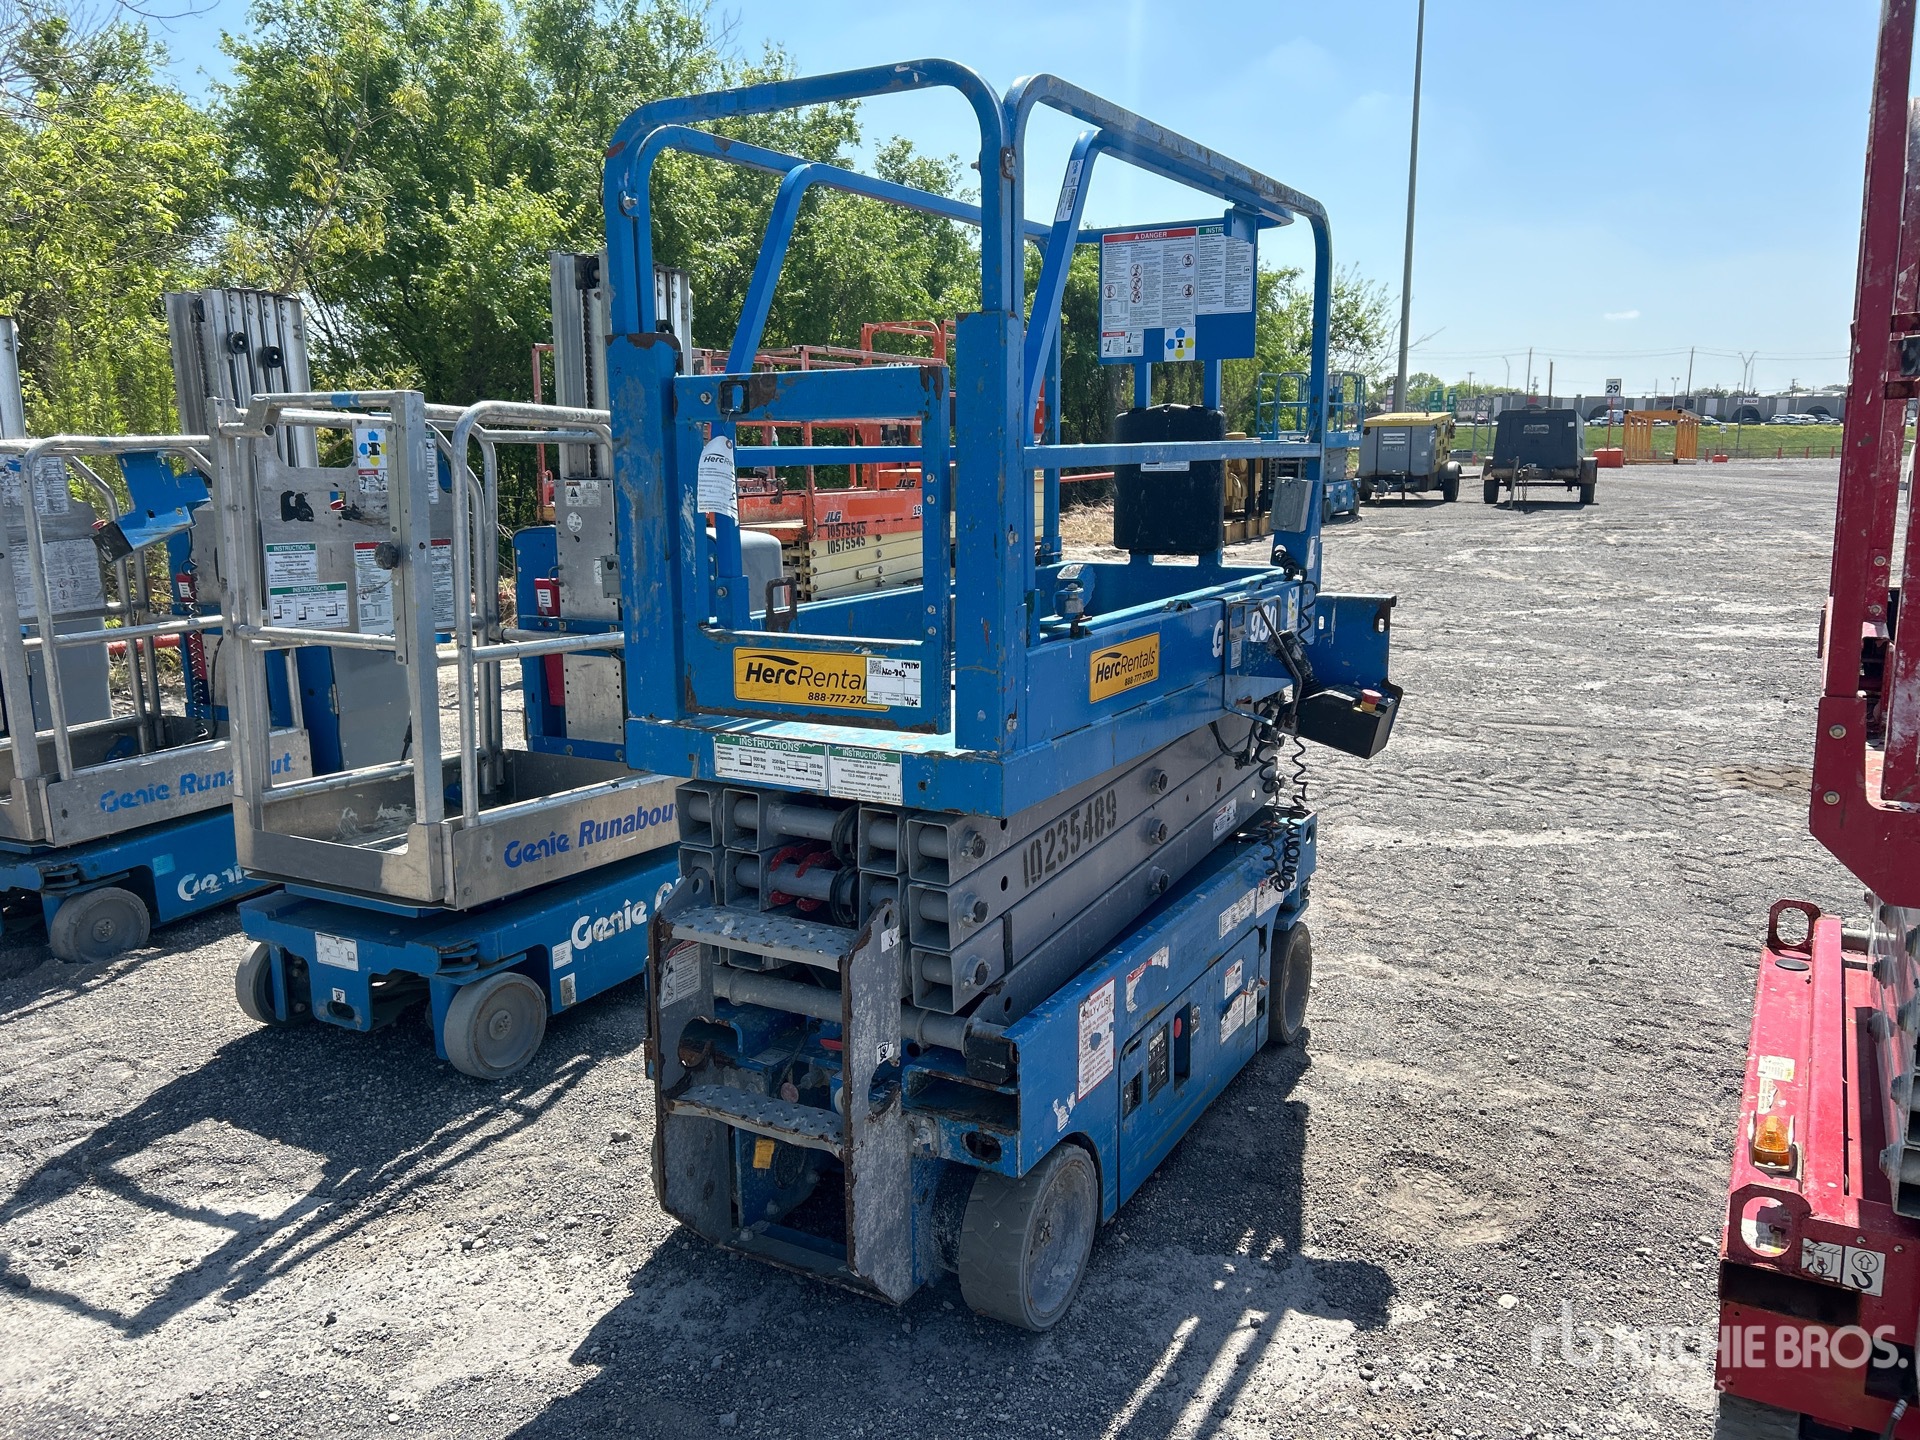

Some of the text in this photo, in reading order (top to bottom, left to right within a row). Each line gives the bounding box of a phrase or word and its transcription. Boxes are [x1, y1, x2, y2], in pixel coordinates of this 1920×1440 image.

[1140, 231, 1168, 239] DANGER
[1205, 226, 1224, 235] INSTR
[1606, 384, 1620, 394] 29
[896, 478, 916, 488] JLG
[825, 511, 842, 523] JLG
[827, 521, 867, 539] 10575545
[273, 544, 311, 552] INSTRUCTIONS
[827, 536, 867, 555] 10575545
[292, 585, 328, 593] INSTRUCTIONS
[1095, 646, 1156, 684] HercRentals
[745, 661, 867, 692] HercRental
[1124, 669, 1154, 686] 888-777-2700
[807, 692, 867, 705] 888-777-270
[739, 737, 800, 752] INSTRUCTIONS
[842, 748, 887, 760] INSTRUCTIONS
[100, 784, 170, 813] Genie
[504, 803, 677, 869] Genie Runabou
[1023, 789, 1117, 889] 10235489
[571, 899, 648, 950] Genie
